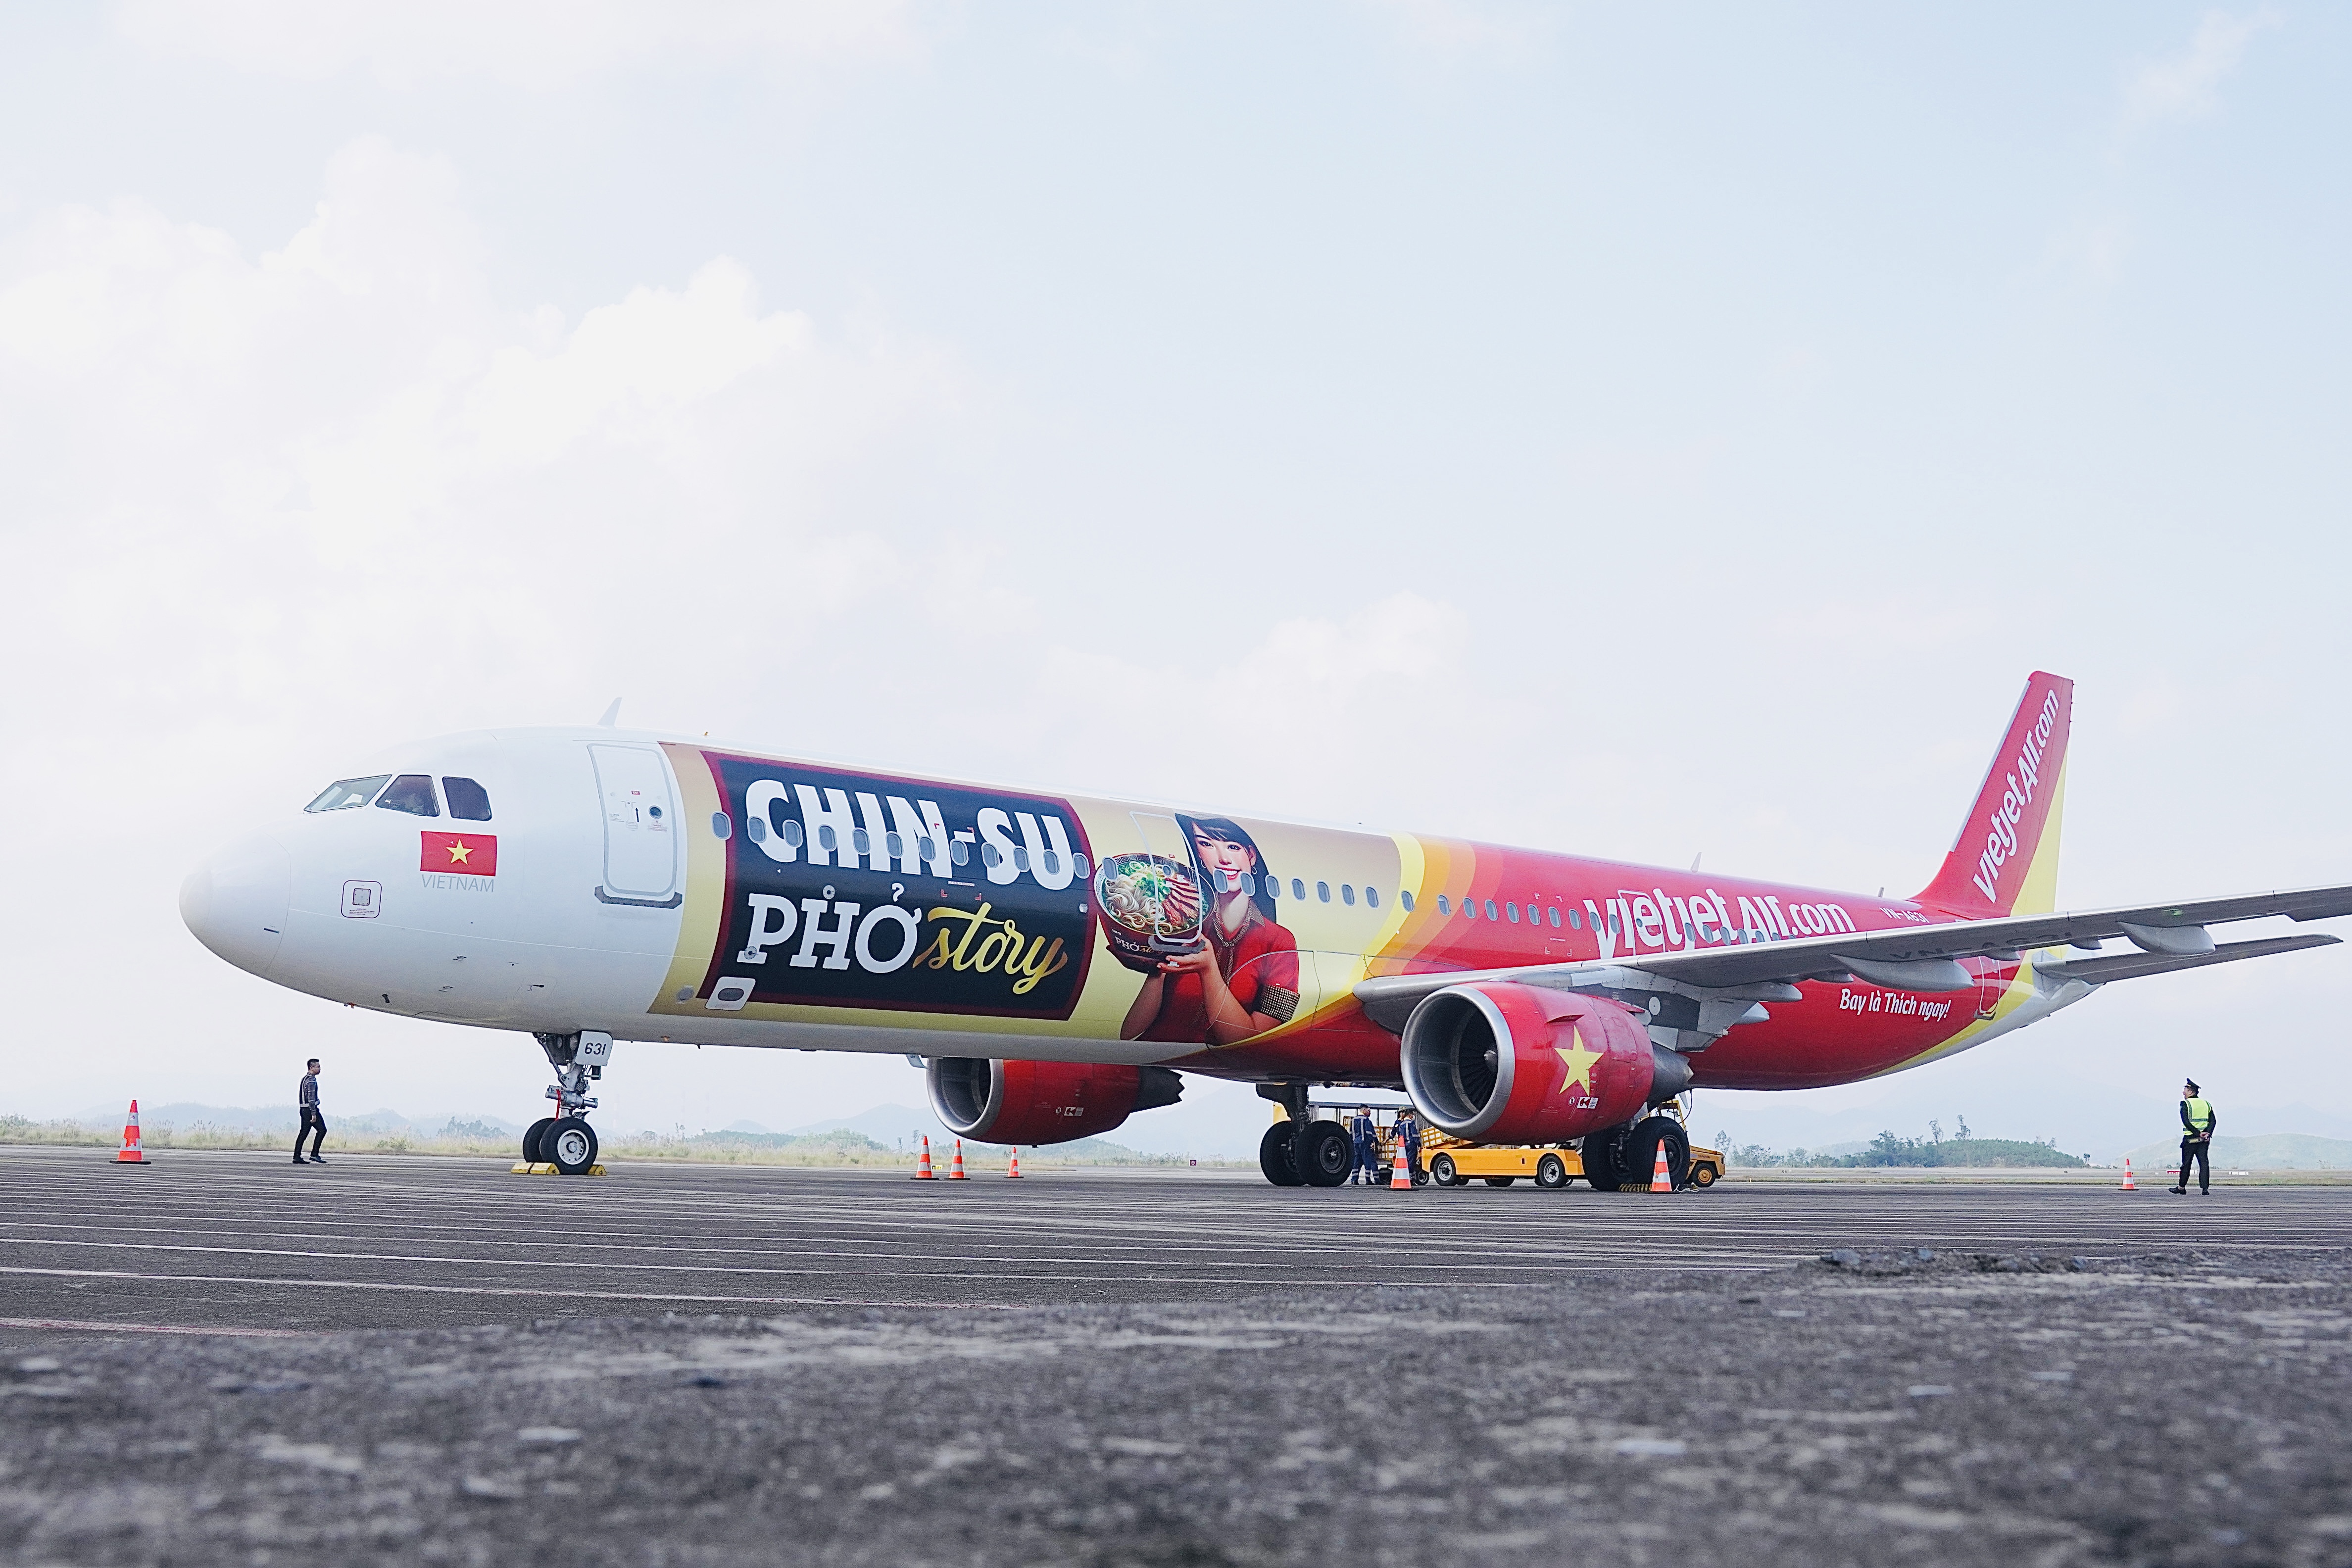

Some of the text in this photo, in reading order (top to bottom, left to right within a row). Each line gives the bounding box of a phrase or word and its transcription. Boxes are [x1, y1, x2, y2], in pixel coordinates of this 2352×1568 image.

[745, 780, 1073, 890] CHIN-SU
[422, 874, 494, 892] VIETNAM
[1879, 907, 1930, 923] VN-A631
[737, 882, 1068, 994] PHỞ story
[1839, 988, 1952, 1022] Bay là Thích ngay!
[585, 1042, 606, 1055] 631
